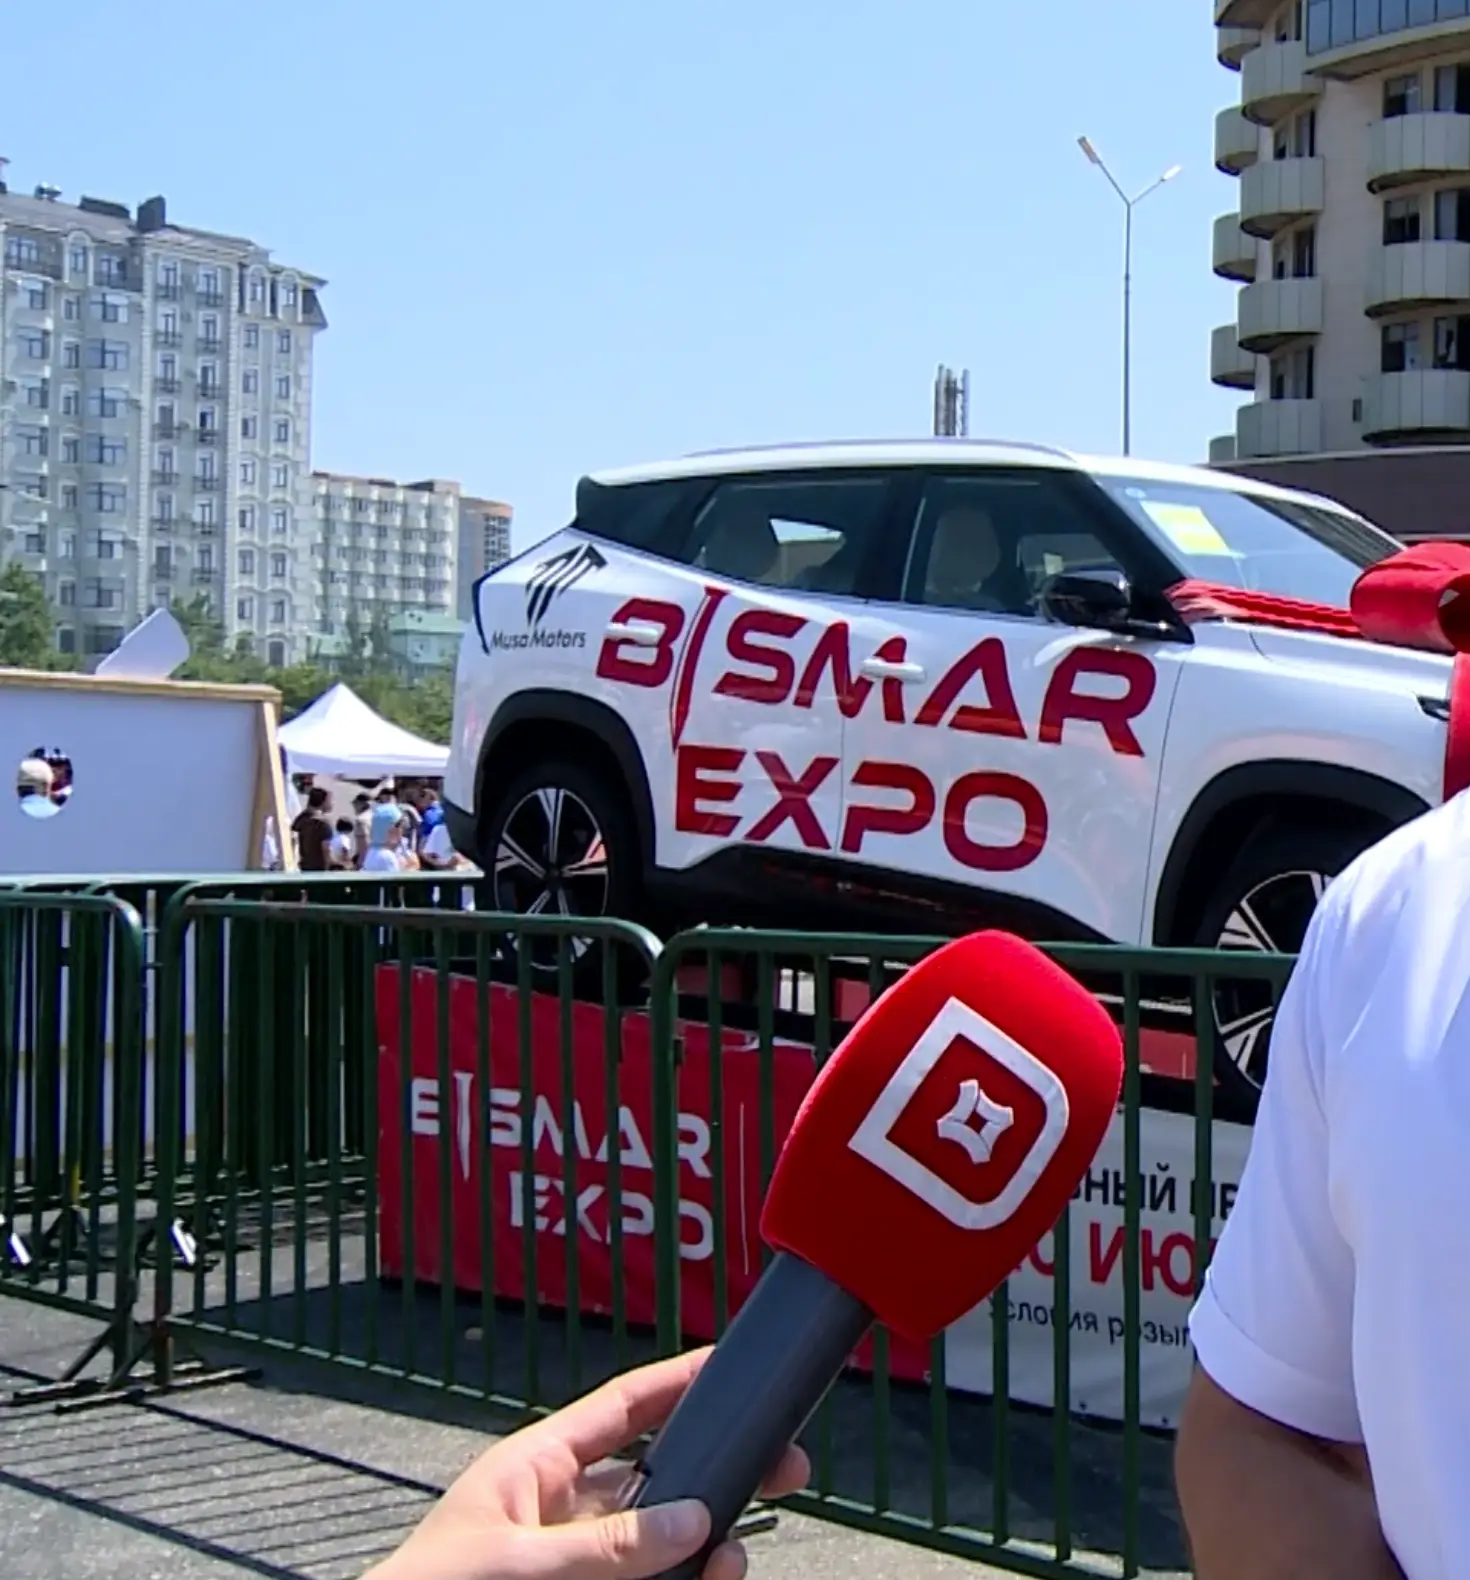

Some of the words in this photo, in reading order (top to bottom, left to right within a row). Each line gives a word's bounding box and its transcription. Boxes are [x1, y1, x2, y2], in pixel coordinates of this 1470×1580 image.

[491, 630, 529, 650] Musa
[529, 628, 587, 649] Motors
[674, 745, 1048, 872] EXPO
[1071, 1162, 1176, 1213] НЫЙ
[1090, 1222, 1218, 1297] ИЮ
